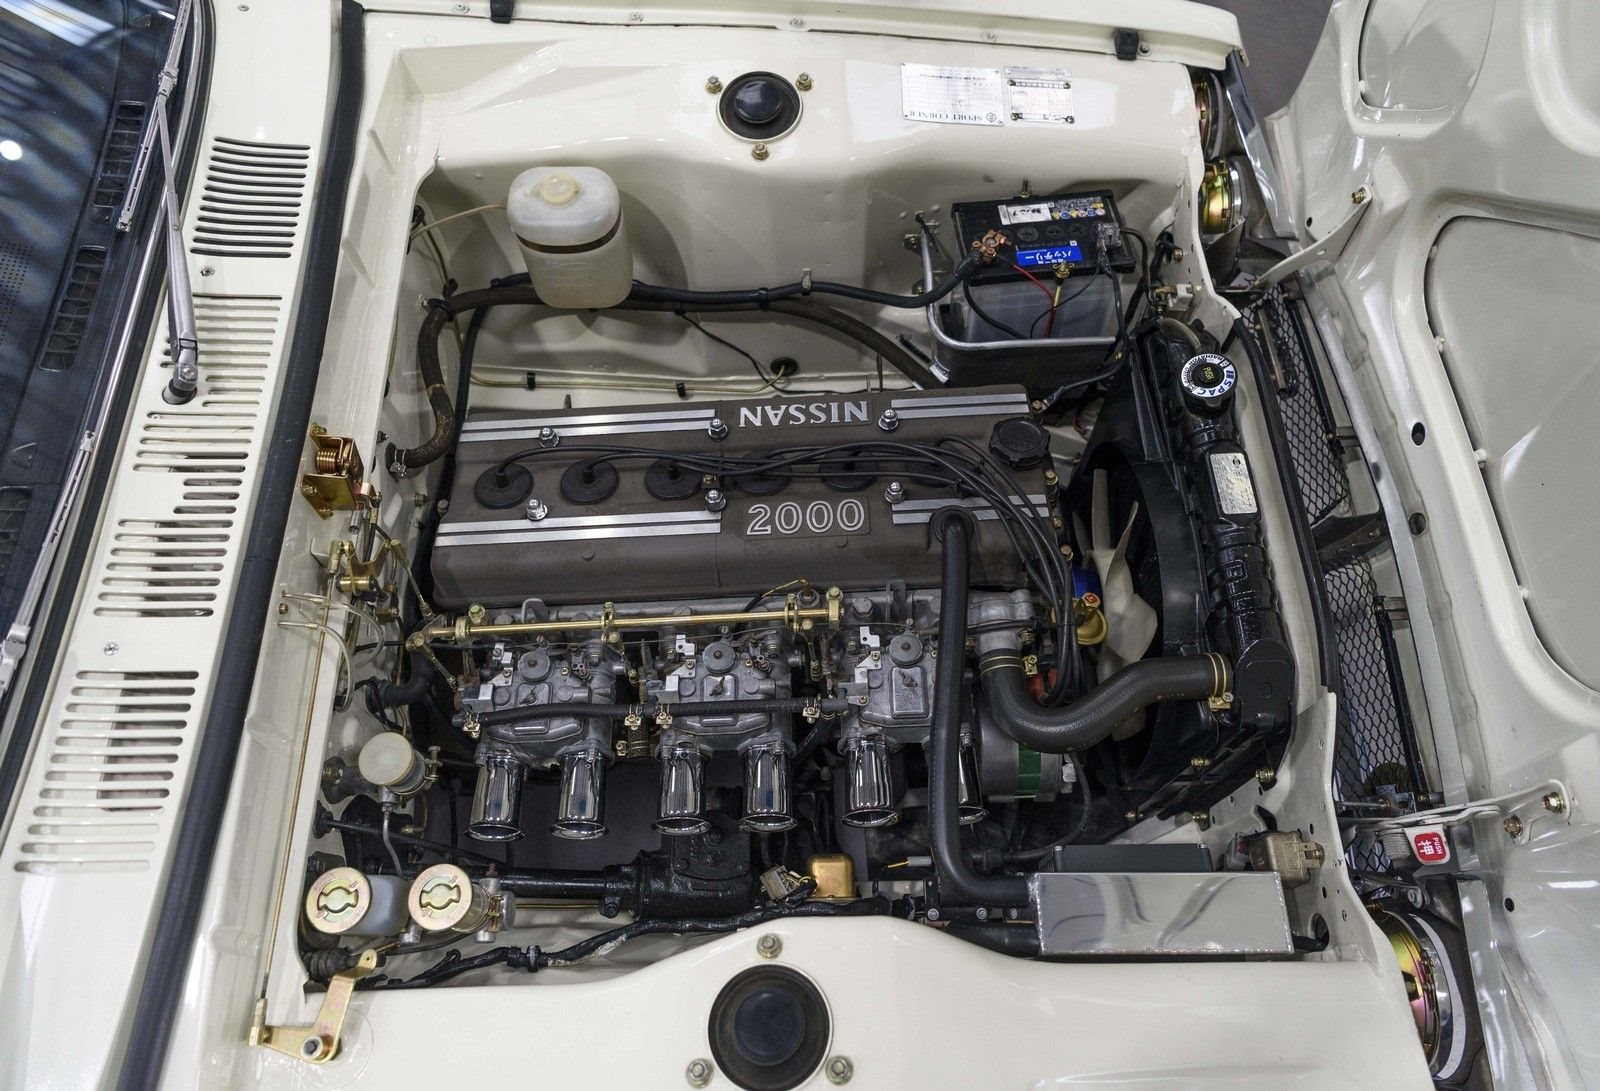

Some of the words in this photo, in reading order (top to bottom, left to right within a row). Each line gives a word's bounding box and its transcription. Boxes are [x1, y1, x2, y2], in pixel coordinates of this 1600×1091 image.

[908, 110, 949, 119] CORNER
[952, 113, 983, 121] SPORT
[1025, 250, 1072, 261] バッテリー
[1203, 366, 1215, 380] PUSH
[739, 400, 869, 428] NISSAN
[746, 498, 866, 536] 2000
[1417, 839, 1435, 855] 押
[1432, 836, 1443, 855] PUSH
